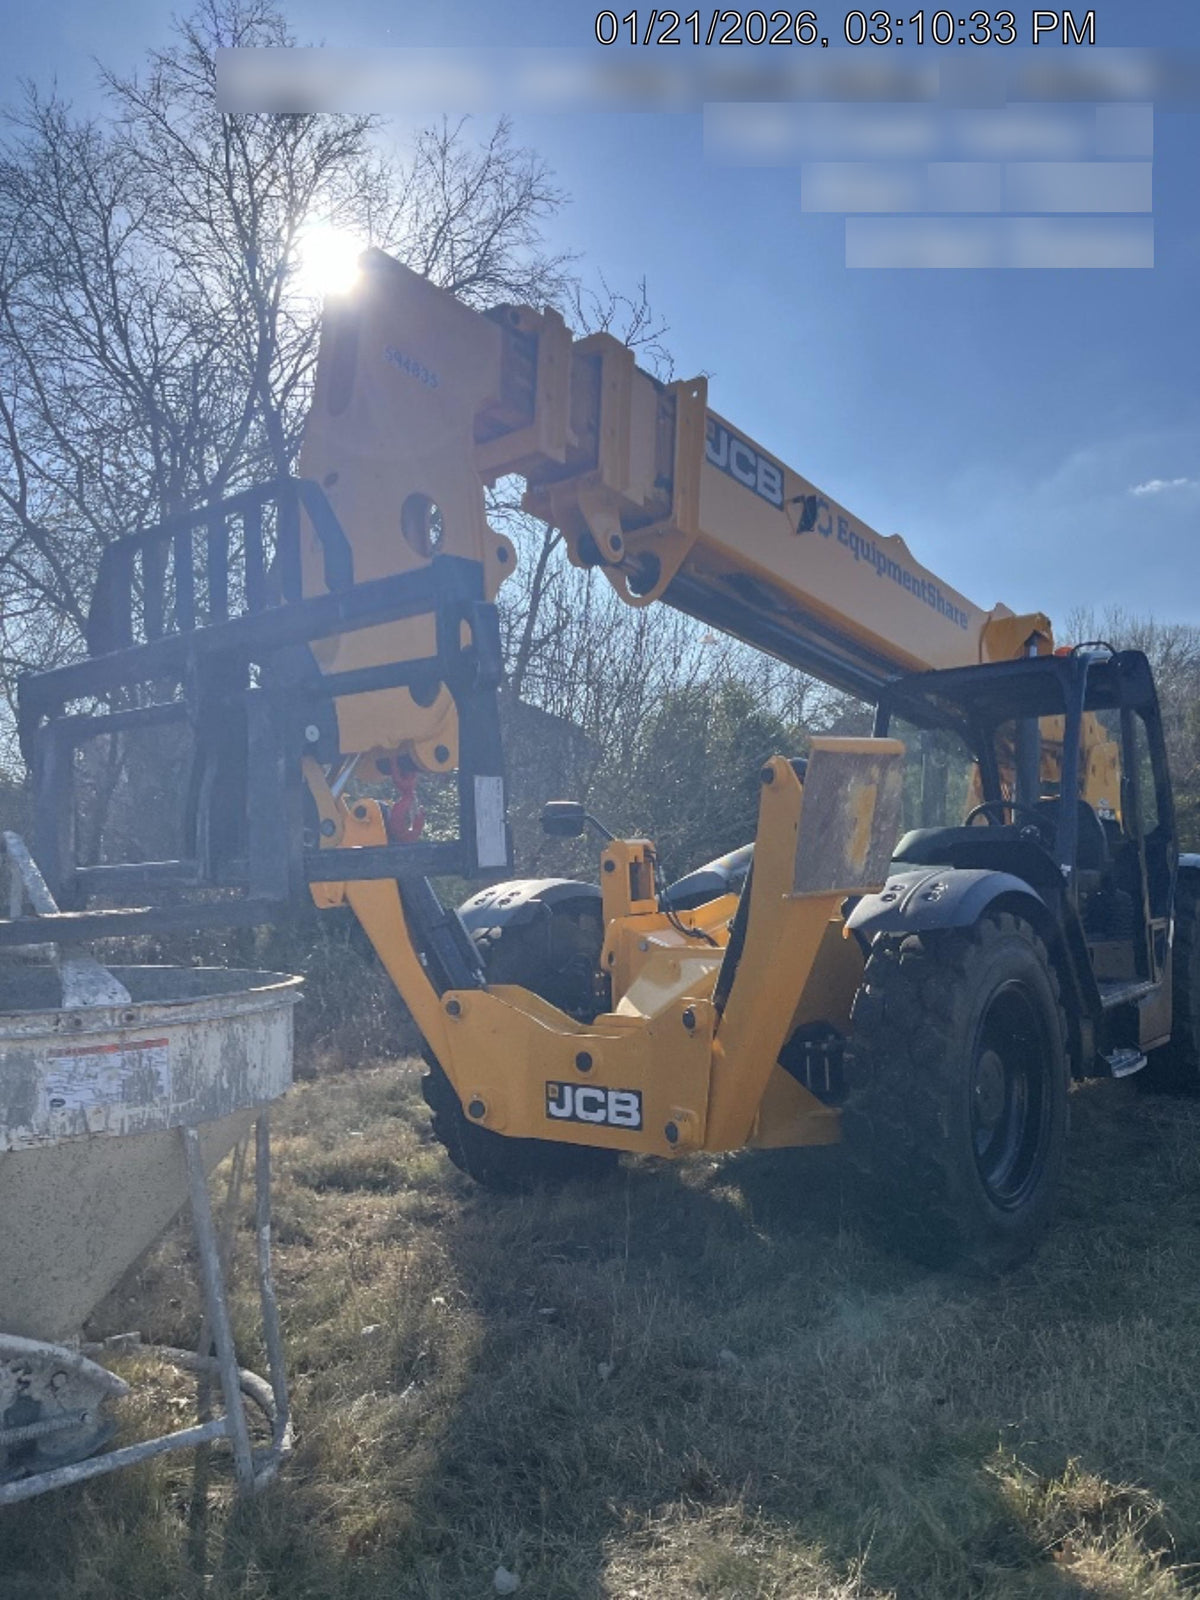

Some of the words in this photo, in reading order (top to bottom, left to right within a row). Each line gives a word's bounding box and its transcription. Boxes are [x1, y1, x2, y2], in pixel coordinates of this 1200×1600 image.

[706, 428, 784, 506] JCB
[837, 515, 968, 630] EquipmentShare
[548, 1085, 641, 1127] JCB
